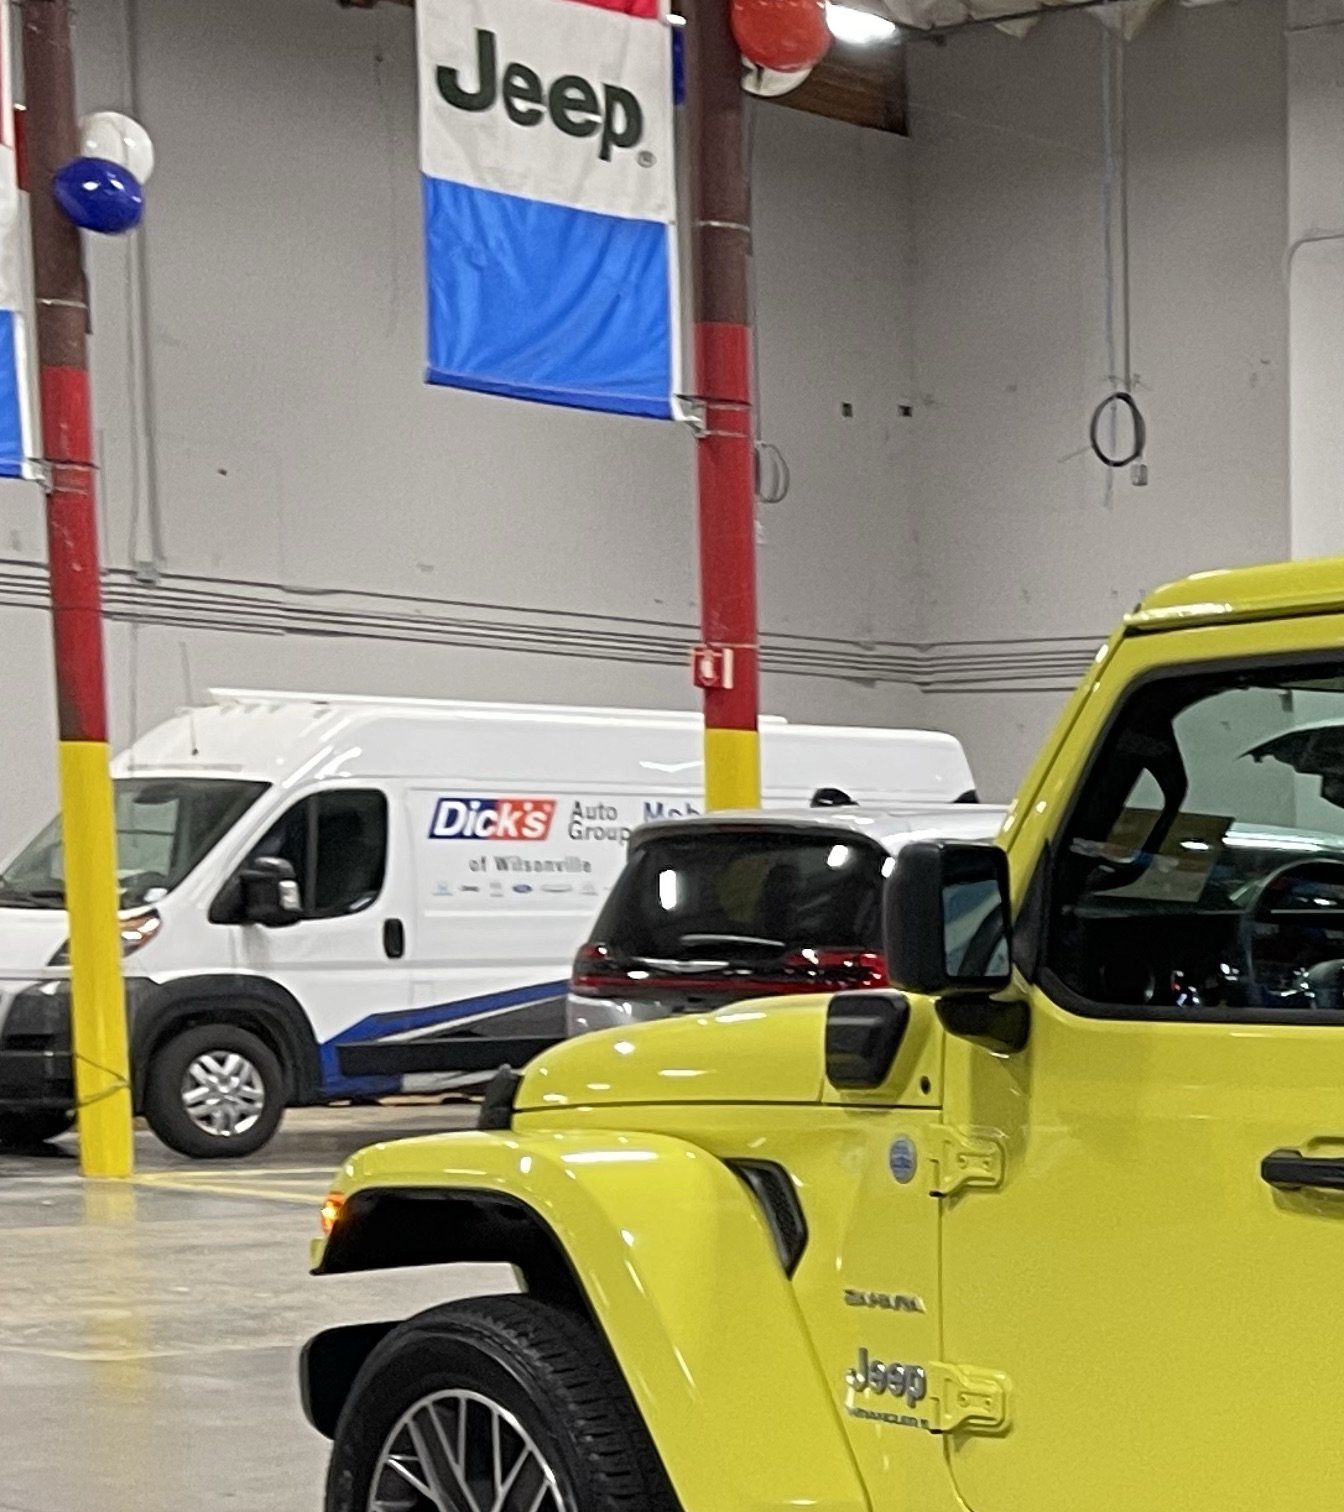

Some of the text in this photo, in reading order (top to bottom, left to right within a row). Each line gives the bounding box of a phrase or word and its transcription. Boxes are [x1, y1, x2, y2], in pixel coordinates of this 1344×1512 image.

[435, 28, 643, 162] Jeep
[433, 800, 548, 838] Dick's
[572, 801, 619, 820] Auto
[568, 820, 632, 845] Group
[469, 855, 592, 873] of Wilsonville
[845, 1347, 928, 1409] Jeep
